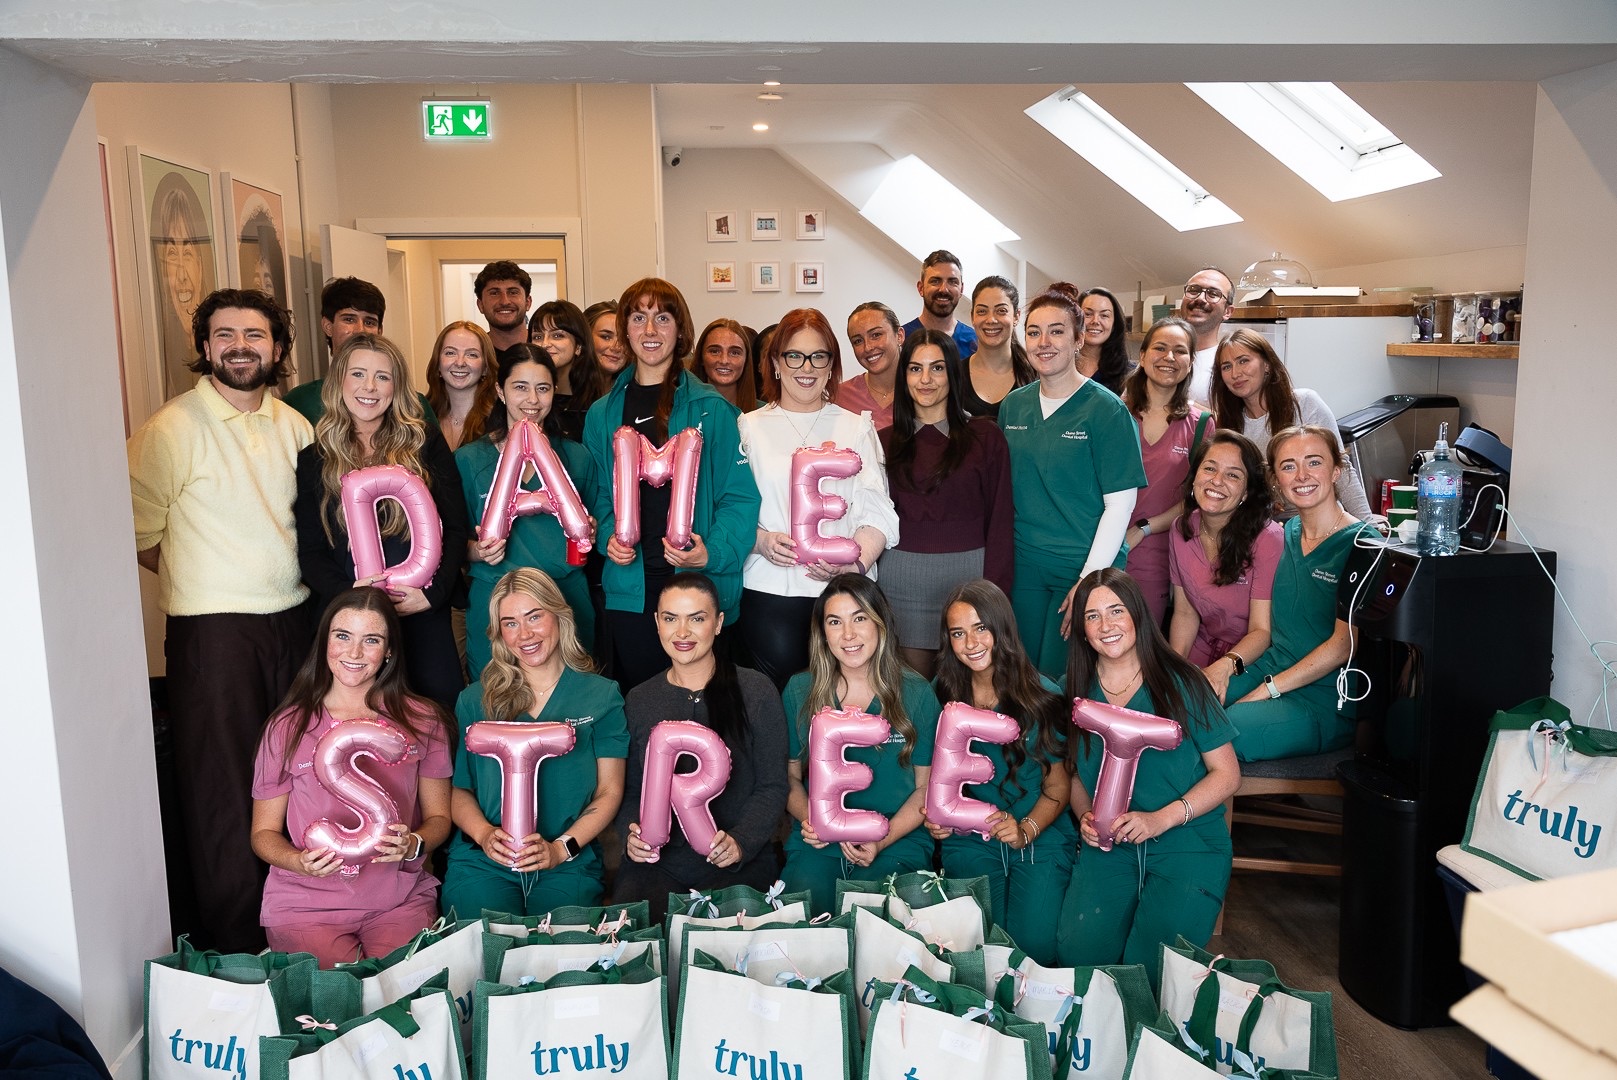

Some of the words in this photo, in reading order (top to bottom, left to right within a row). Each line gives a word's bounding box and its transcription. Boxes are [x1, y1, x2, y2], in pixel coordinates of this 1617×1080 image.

[340, 418, 863, 590] DAME
[303, 696, 1183, 866] STREET
[1503, 789, 1602, 859] truly
[168, 1028, 247, 1080] truly
[530, 1033, 630, 1076] truly
